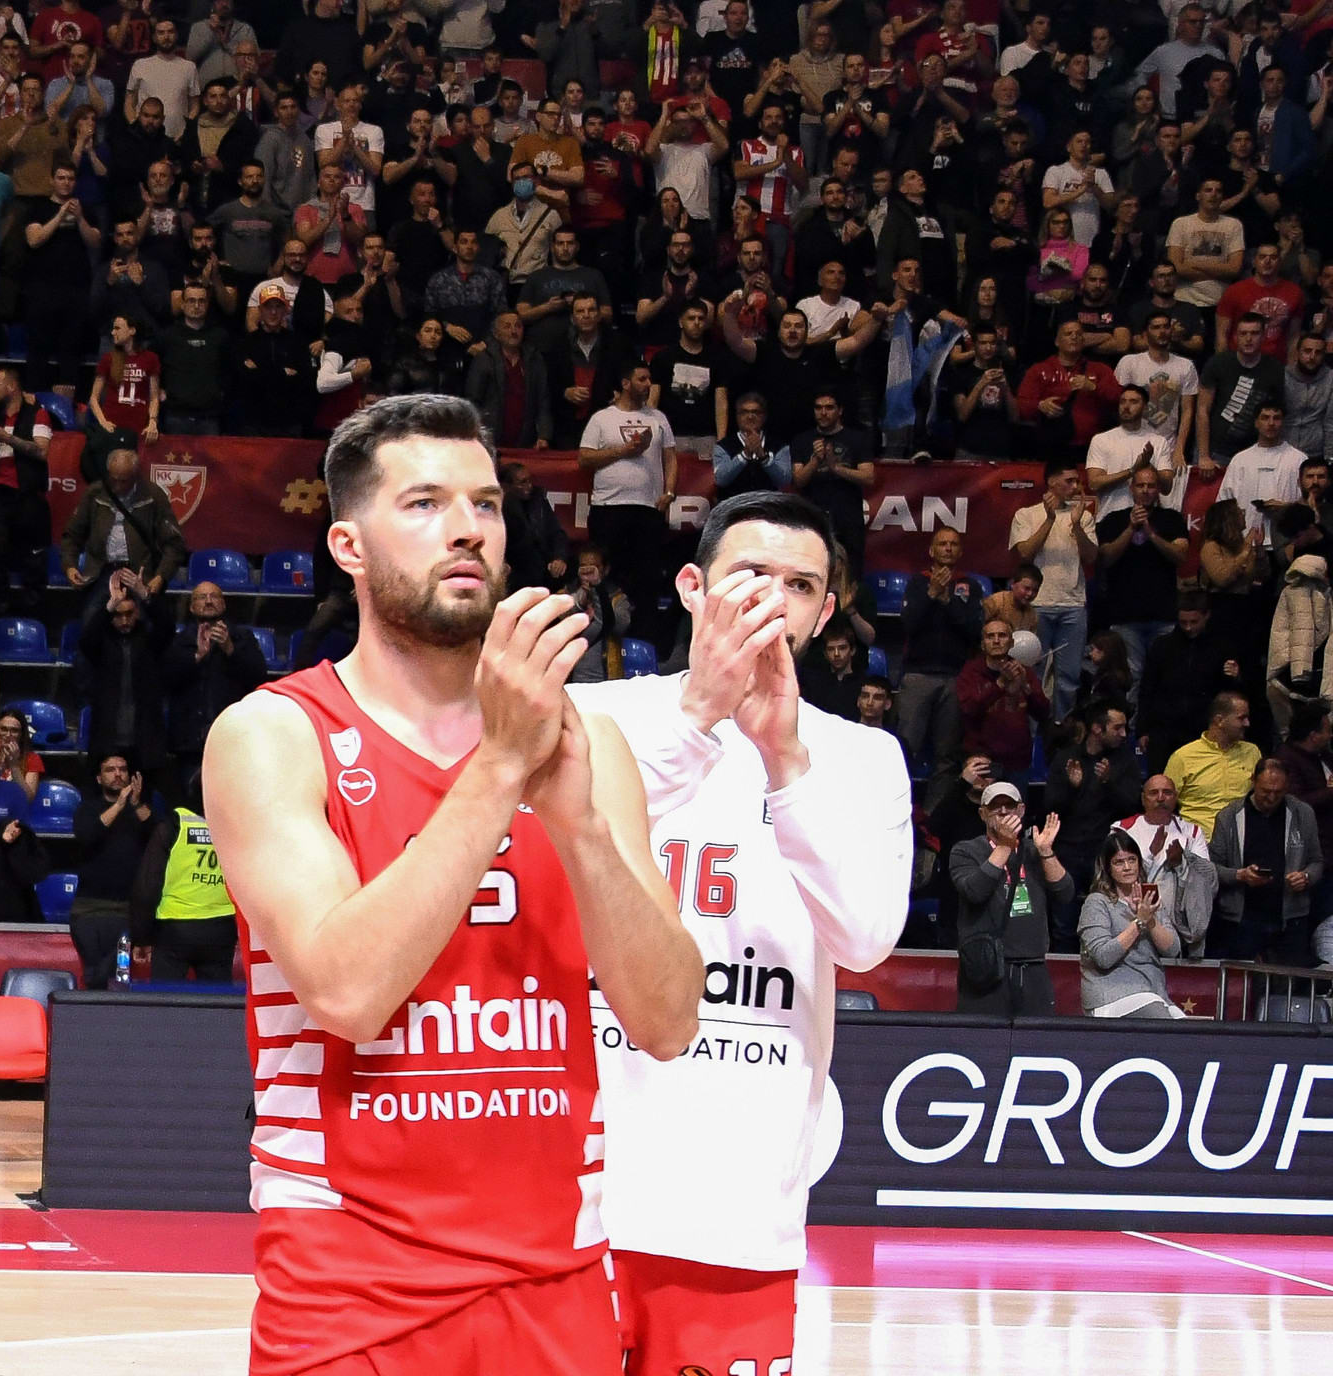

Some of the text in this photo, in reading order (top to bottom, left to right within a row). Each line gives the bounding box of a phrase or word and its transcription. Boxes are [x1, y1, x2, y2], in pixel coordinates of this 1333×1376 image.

[1220, 375, 1254, 423] PUMA
[660, 838, 739, 918] 16
[349, 1088, 571, 1122] FOUNDATION
